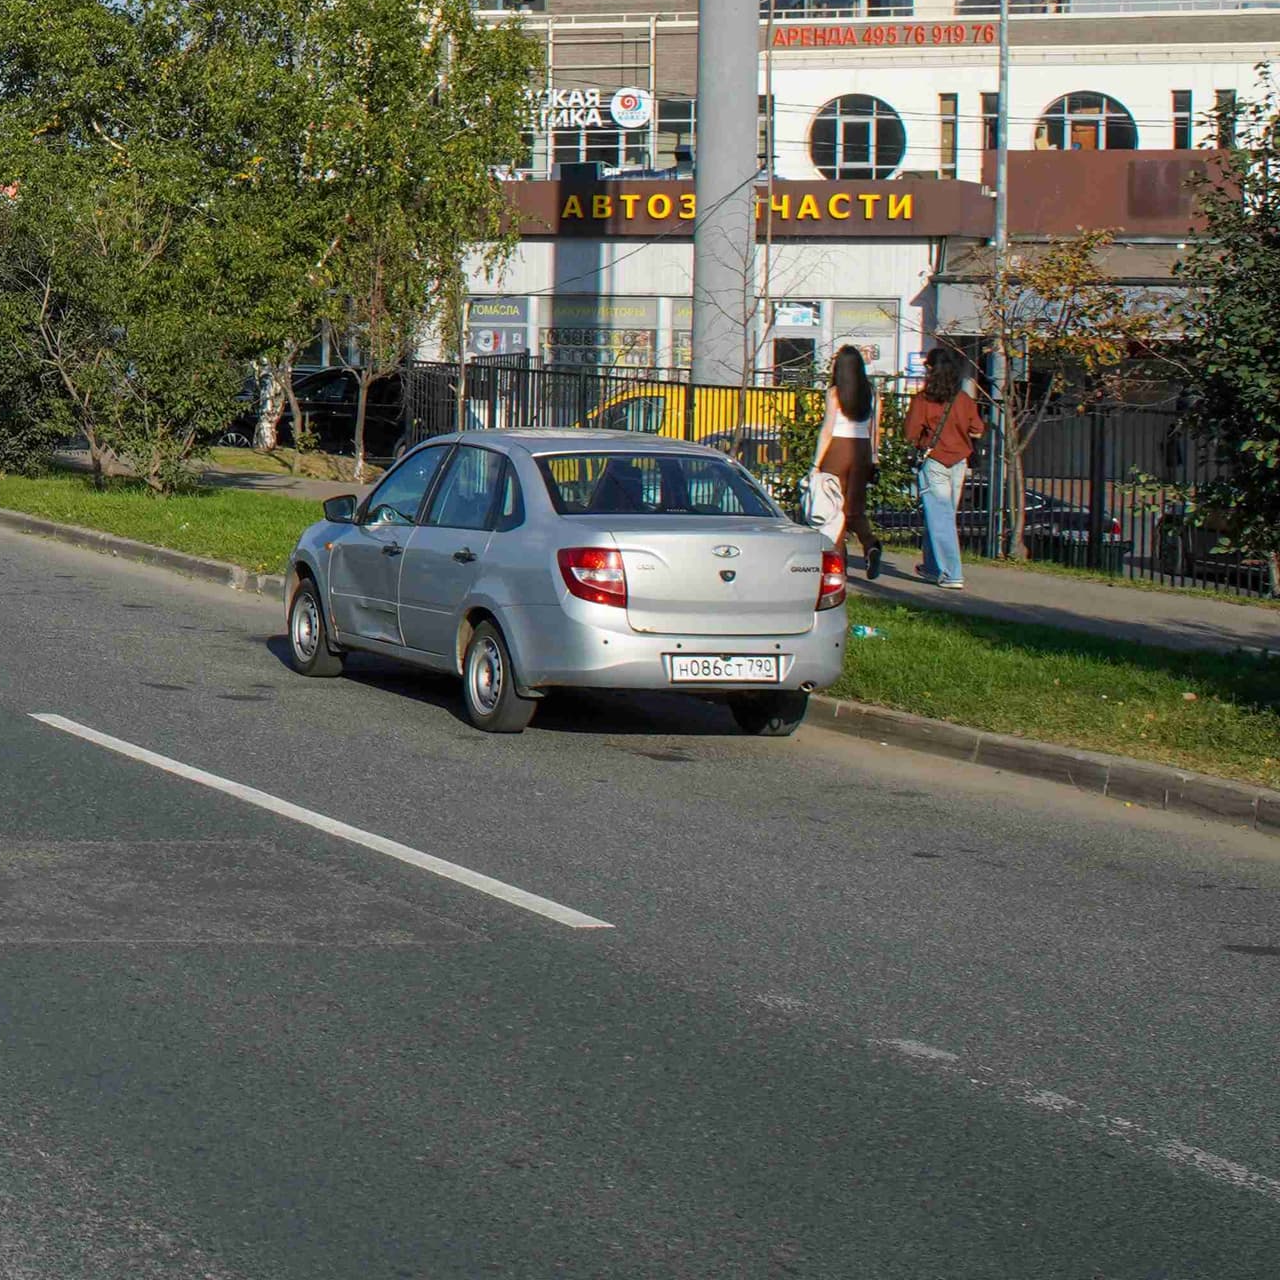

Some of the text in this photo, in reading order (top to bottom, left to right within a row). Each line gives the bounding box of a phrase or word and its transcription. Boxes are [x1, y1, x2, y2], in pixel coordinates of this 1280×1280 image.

[773, 24, 995, 47] АРЕНДА 495 76 919 76
